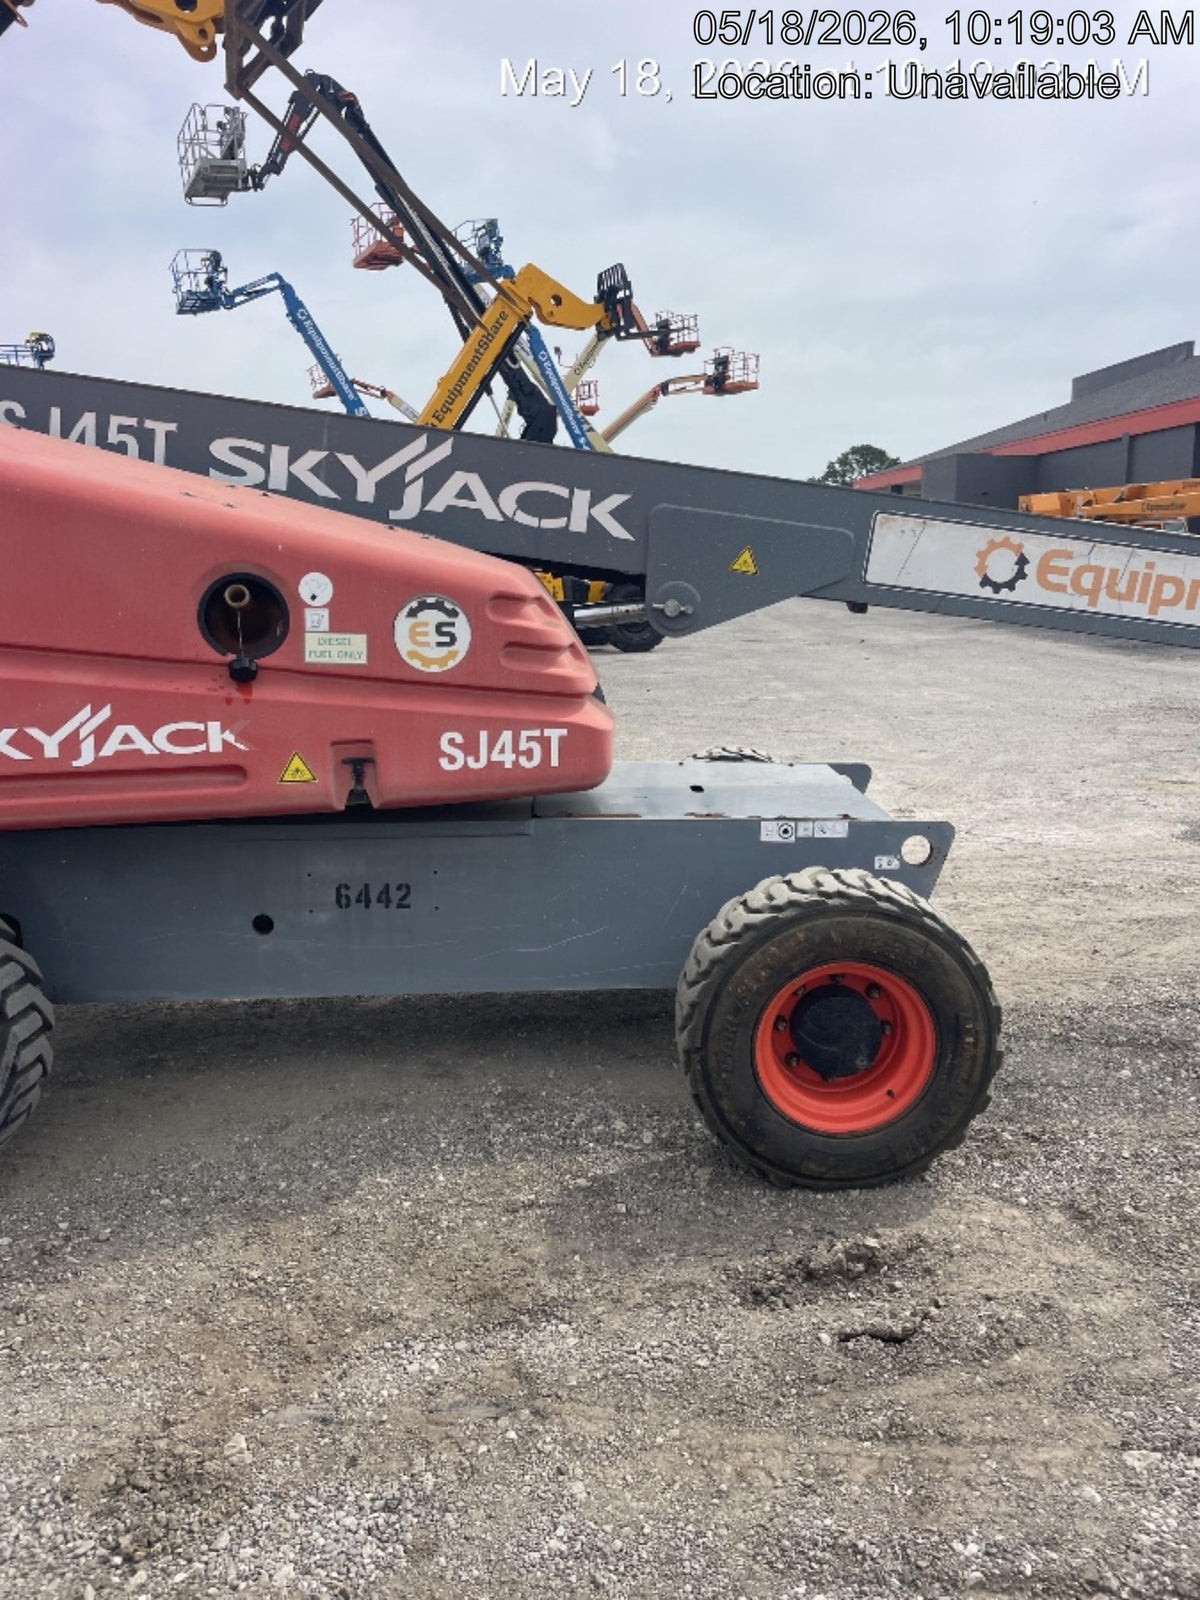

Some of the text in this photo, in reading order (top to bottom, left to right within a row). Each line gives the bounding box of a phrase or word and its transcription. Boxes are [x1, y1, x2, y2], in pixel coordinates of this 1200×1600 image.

[208, 433, 635, 541] SKYJACK
[317, 637, 354, 647] DIESEL
[408, 621, 458, 648] ES
[308, 650, 364, 661] FUEL ONLY
[438, 728, 568, 771] SJ45T
[335, 882, 411, 910] 6442
